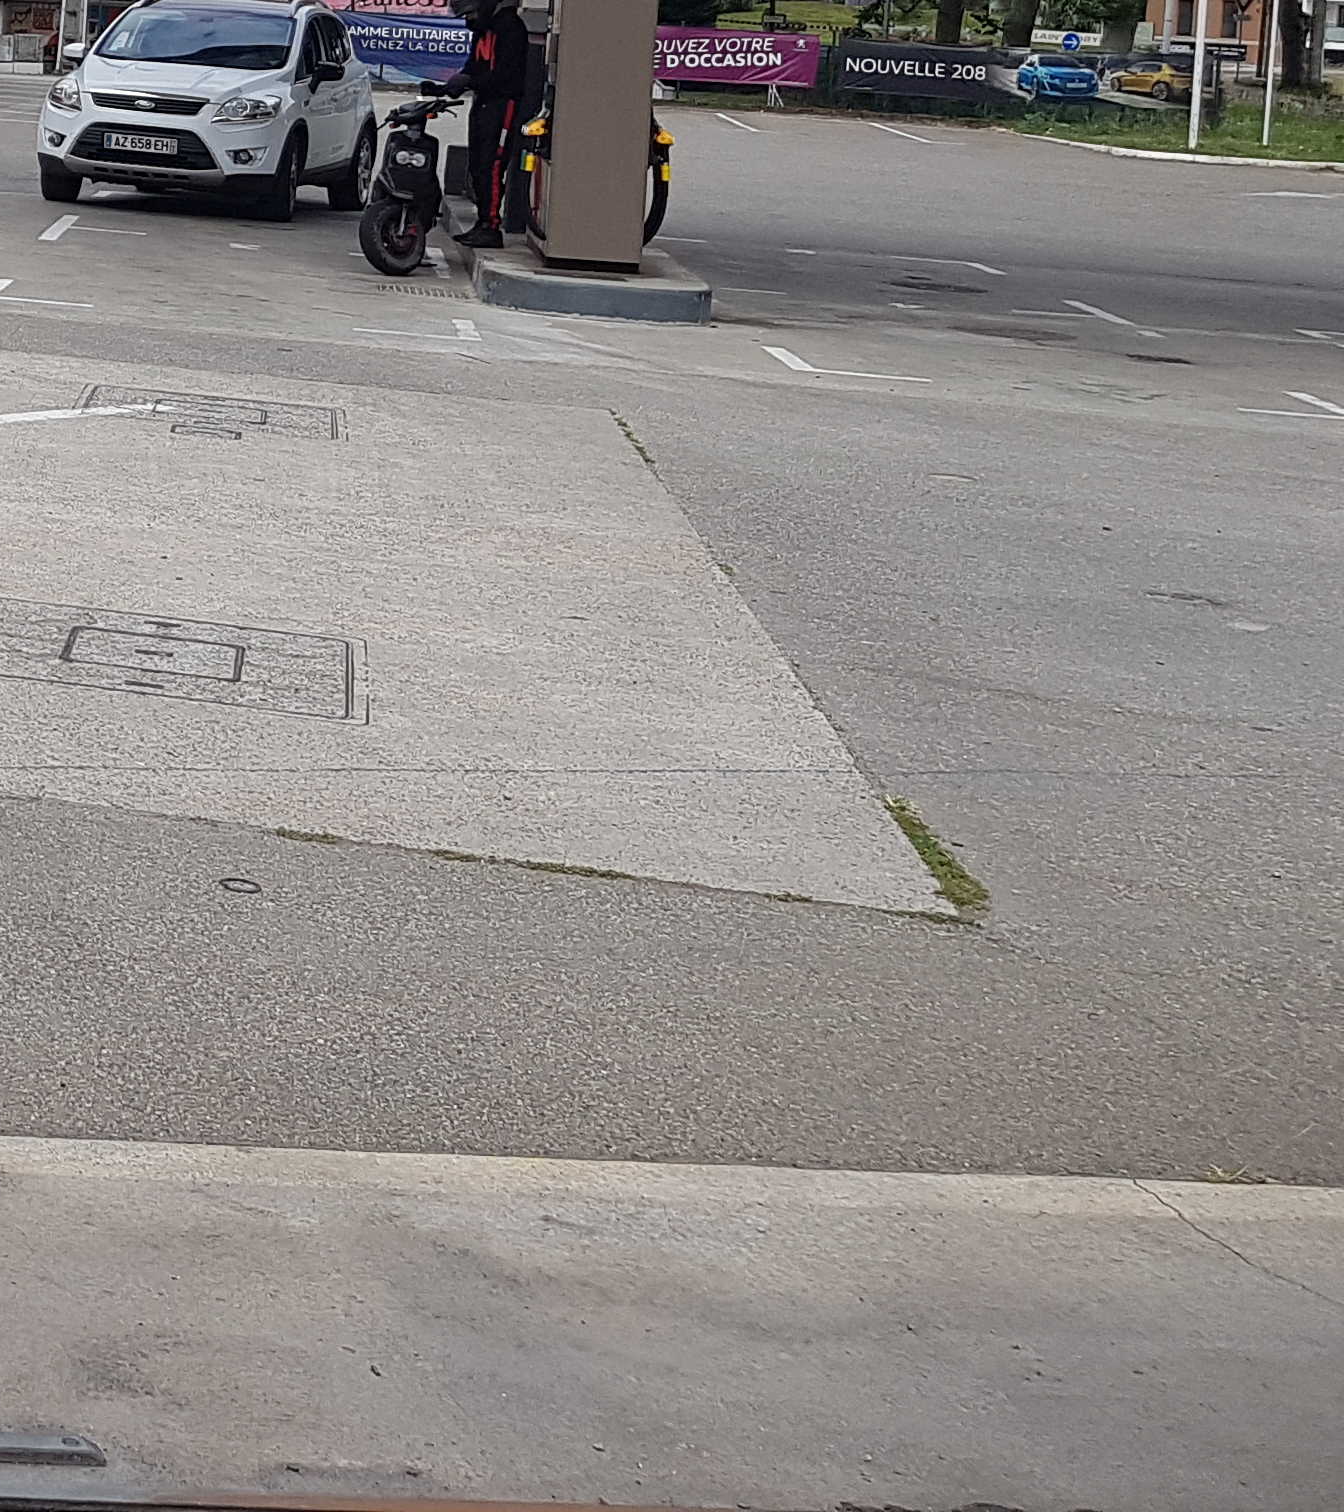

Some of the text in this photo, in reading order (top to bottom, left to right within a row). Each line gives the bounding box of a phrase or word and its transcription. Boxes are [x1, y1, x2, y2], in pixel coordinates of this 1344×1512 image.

[347, 25, 390, 39] AMME
[392, 28, 466, 42] UTILITAIRES
[361, 39, 471, 54] VENEZ LA DÉCO
[653, 37, 776, 54] OUVEZ VOTRE
[666, 52, 783, 68] D'OCCASION
[845, 57, 987, 81] NOUVELLE 208
